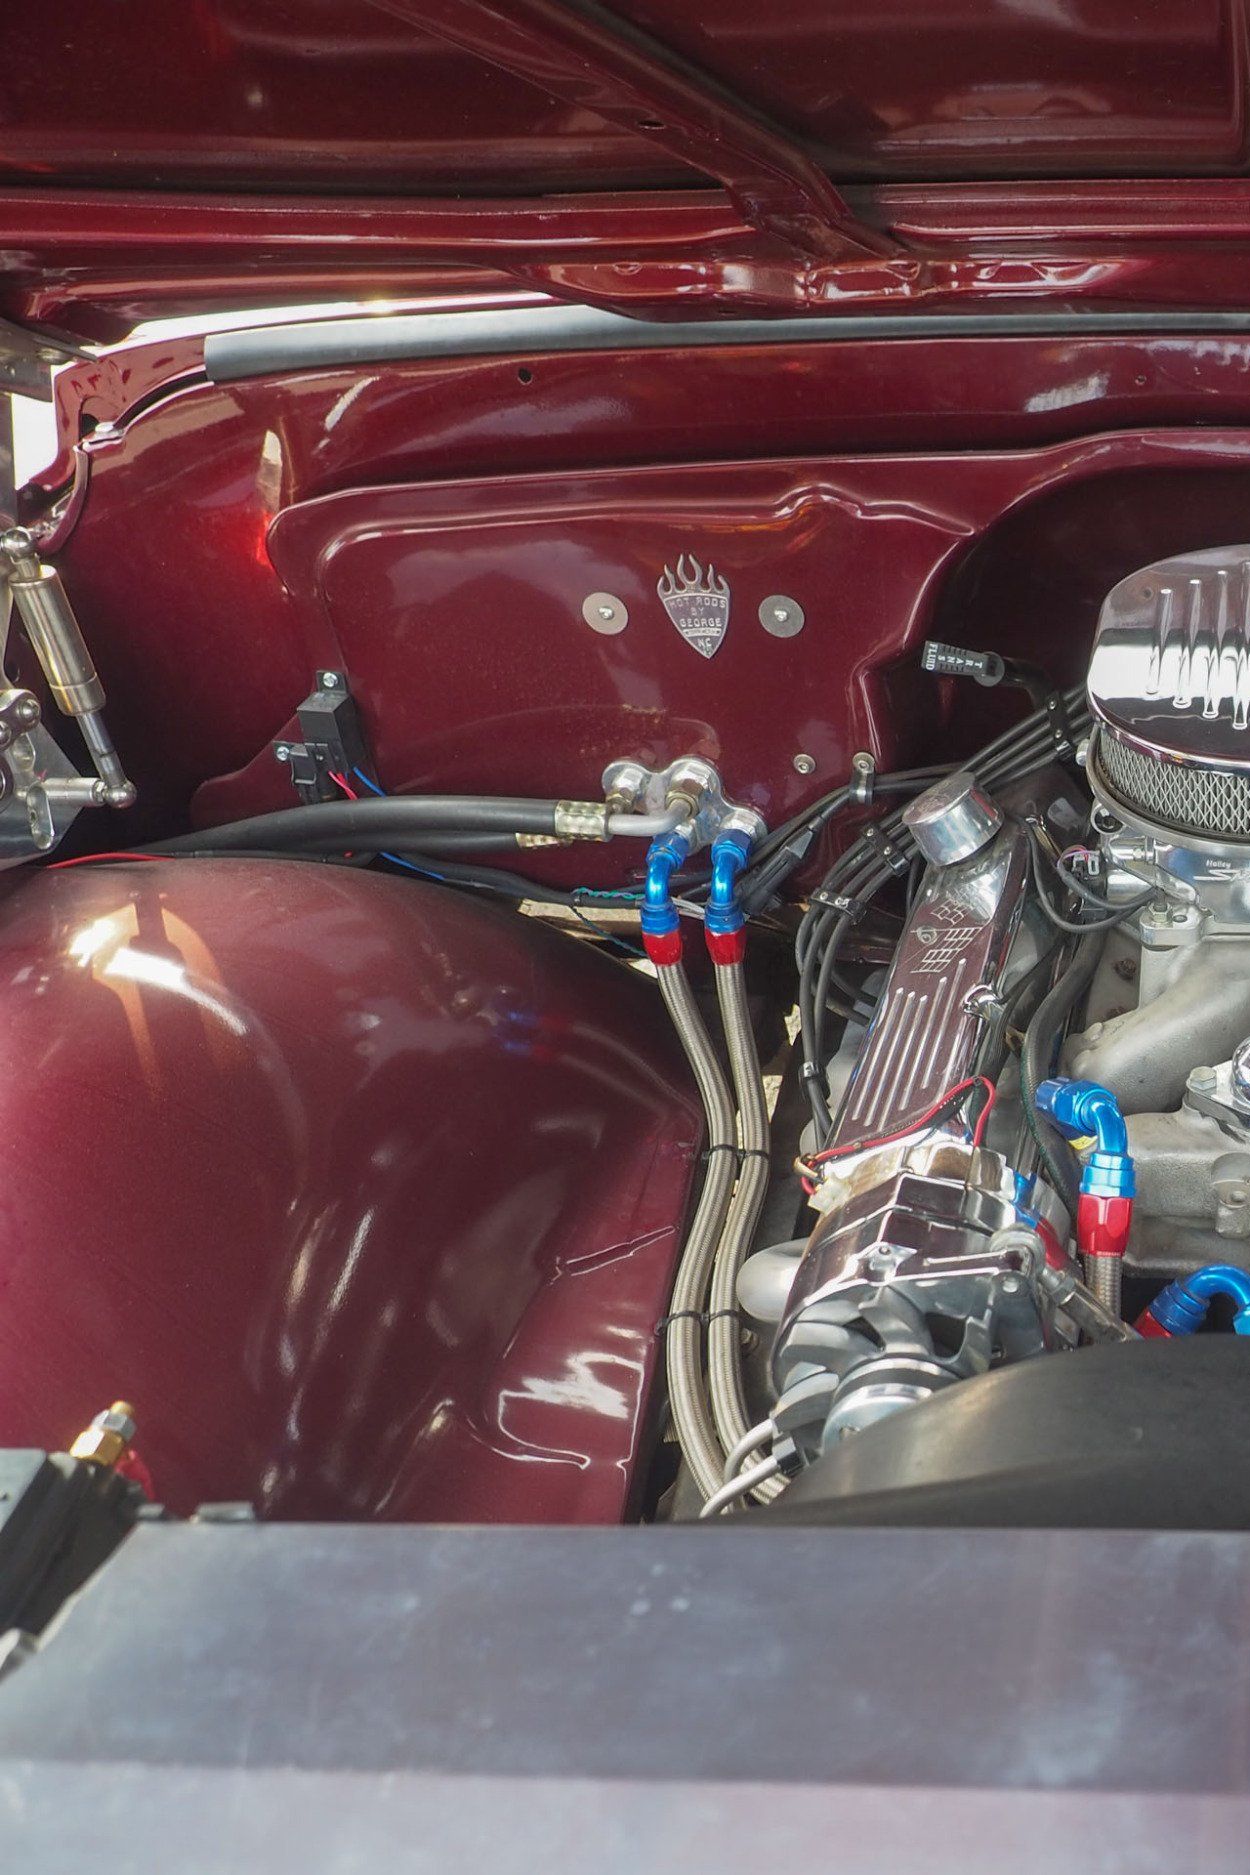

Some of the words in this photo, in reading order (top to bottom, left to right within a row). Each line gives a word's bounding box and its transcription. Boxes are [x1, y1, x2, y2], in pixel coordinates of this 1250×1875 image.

[669, 598, 690, 608] HOT
[696, 597, 726, 608] RODS
[691, 607, 704, 616] BY
[680, 618, 722, 627] GEORGE
[925, 643, 938, 671] FLUID
[937, 655, 983, 669] TRANS
[1205, 859, 1231, 868] Holley
